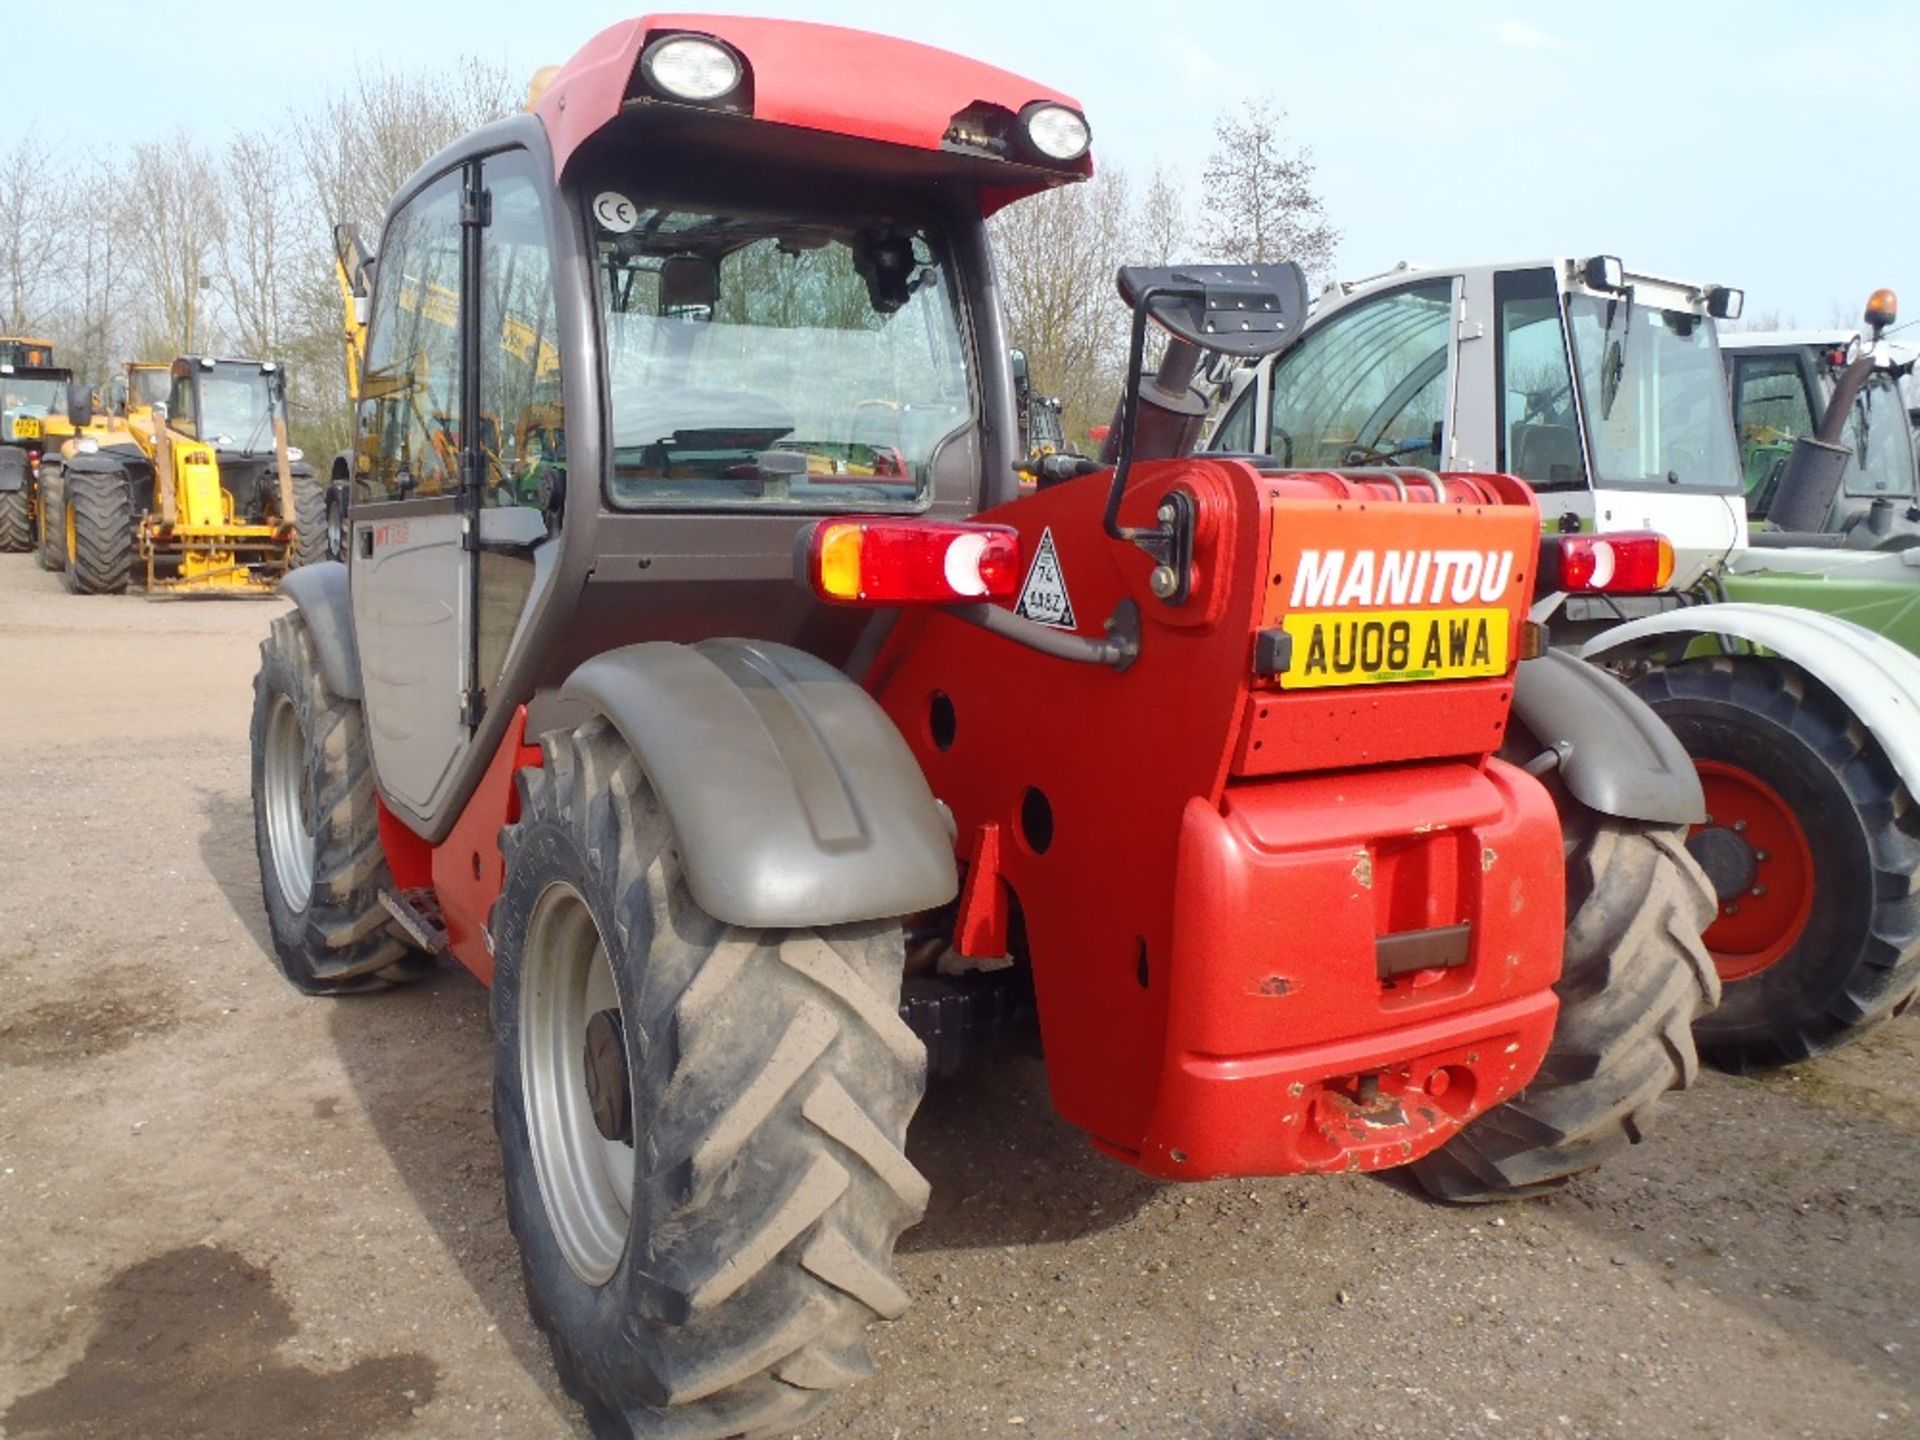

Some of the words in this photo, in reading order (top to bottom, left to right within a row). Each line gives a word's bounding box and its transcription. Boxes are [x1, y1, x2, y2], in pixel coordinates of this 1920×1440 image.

[598, 200, 630, 224] CE
[1289, 550, 1514, 607] MANITOU
[1304, 620, 1411, 676] AU08
[1422, 617, 1490, 669] AWA
